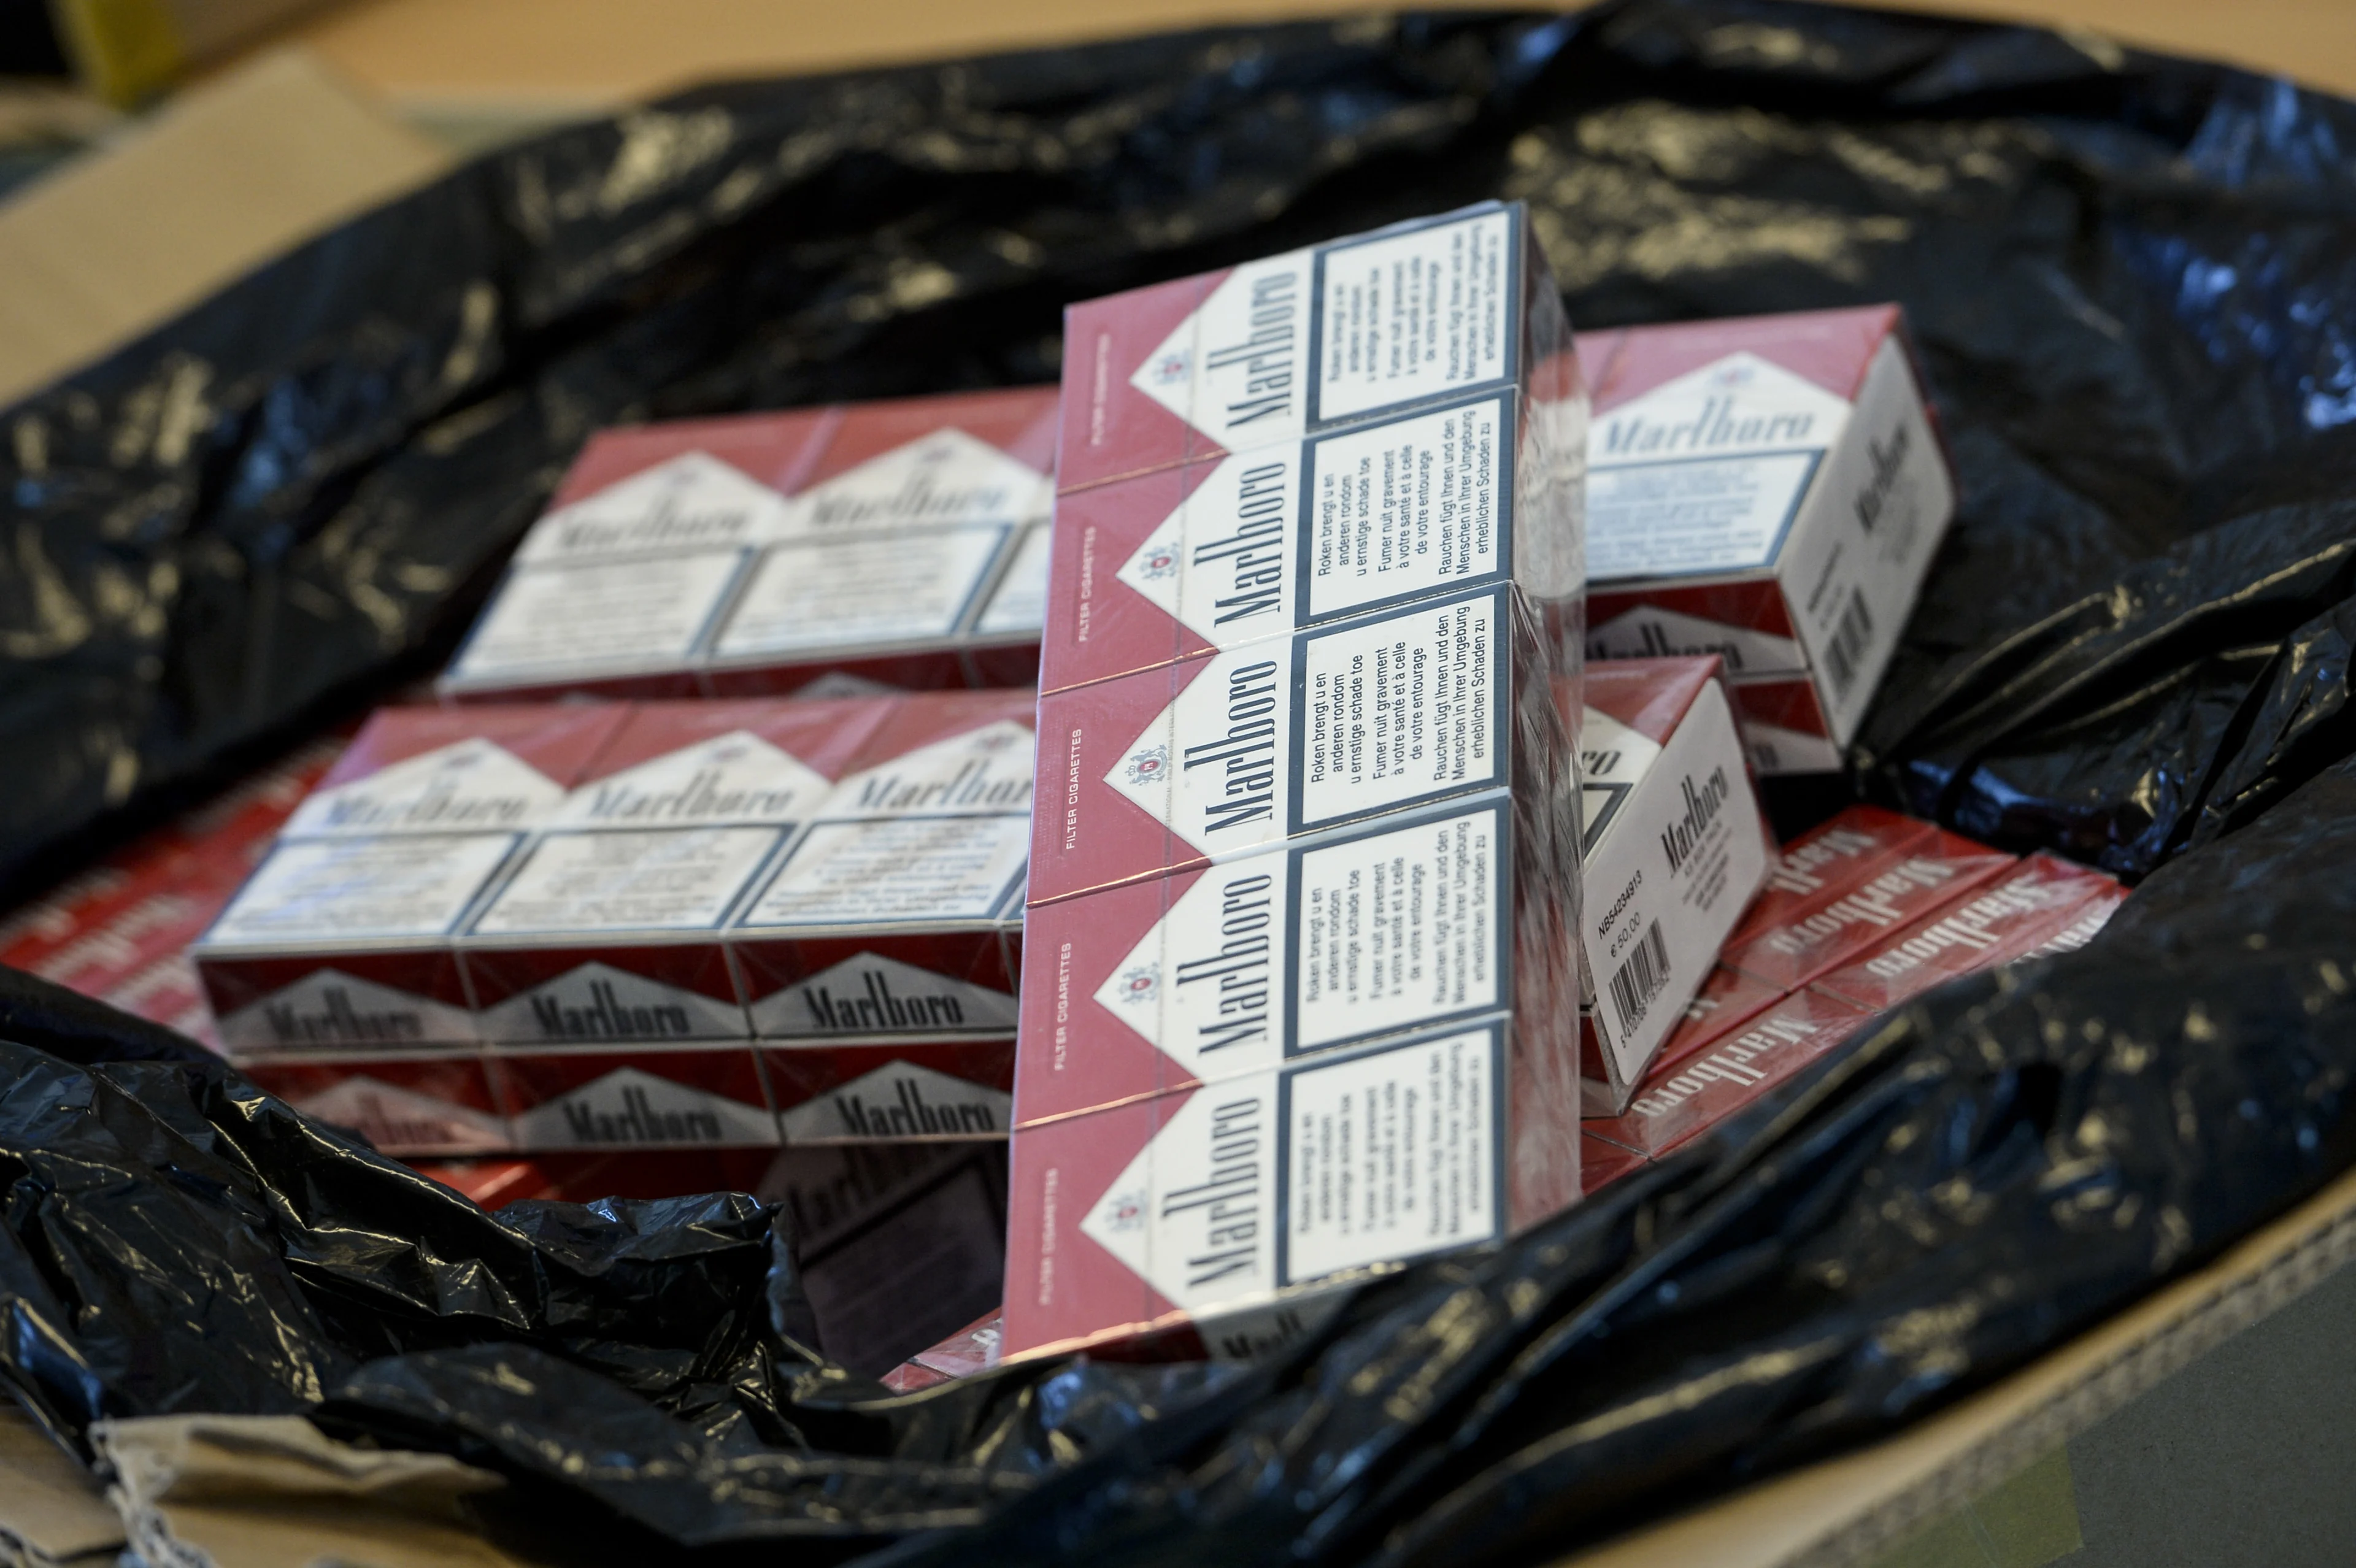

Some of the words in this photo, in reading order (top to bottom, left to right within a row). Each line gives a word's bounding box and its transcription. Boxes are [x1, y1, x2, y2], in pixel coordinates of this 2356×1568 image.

[1206, 270, 1298, 430] Marlboro
[1442, 418, 1455, 440] den
[1458, 410, 1477, 473] Umgebung
[1479, 421, 1491, 436] zu
[1358, 456, 1371, 476] toe
[1399, 444, 1413, 471] celle
[1441, 442, 1455, 464] und
[1476, 437, 1490, 487] Schaden
[1323, 473, 1334, 488] en
[1323, 489, 1334, 499] u
[1339, 474, 1352, 518] rondom
[1356, 477, 1370, 518] schade
[1382, 449, 1397, 509] gravement
[1399, 482, 1412, 494] et
[1416, 450, 1434, 507] entourage
[1440, 465, 1454, 498] Ihnen
[1457, 475, 1472, 502] Ihrer
[1319, 499, 1337, 538] brengt
[1379, 510, 1393, 533] nuit
[1397, 496, 1411, 528] santé
[1415, 509, 1429, 539] votre
[1439, 499, 1457, 523] fügt
[1457, 502, 1471, 515] in
[1474, 488, 1489, 554] erheblichen
[1193, 462, 1286, 628] Marlboro
[1317, 539, 1332, 577] Roken
[1336, 520, 1350, 566] anderen
[1354, 520, 1372, 566] ernstige
[1377, 536, 1392, 572] Fumer
[1397, 529, 1411, 559] votre
[1414, 540, 1428, 555] de
[1438, 524, 1453, 575] Rauchen
[1455, 515, 1471, 575] Menschen
[1081, 527, 1096, 599] CIGARETTES
[1356, 567, 1367, 577] u
[1395, 560, 1409, 569] à
[1079, 602, 1090, 641] FILTER
[1434, 614, 1449, 637] den
[1452, 605, 1471, 672] Umgebung
[1474, 618, 1485, 634] zu
[1349, 654, 1363, 675] toe
[1392, 641, 1406, 670] celle
[1434, 639, 1449, 663] und
[1470, 634, 1485, 687] Schaden
[1315, 672, 1326, 688] en
[1315, 690, 1326, 699] u
[1374, 647, 1391, 712] gravement
[1391, 671, 1406, 680] à
[1392, 682, 1406, 696] et
[1410, 647, 1427, 709] entourage
[1434, 664, 1449, 699] Ihnen
[1452, 674, 1466, 702] Ihrer
[1330, 674, 1345, 721] rondom
[1348, 677, 1363, 721] schade
[1391, 698, 1406, 732] santé
[1433, 699, 1452, 726] fügt
[1452, 703, 1466, 717] in
[1311, 700, 1330, 742] brengt
[1372, 713, 1387, 738] nuit
[1409, 710, 1423, 743] votre
[1470, 688, 1485, 759] erheblichen
[1068, 729, 1081, 804] CIGARETTES
[1183, 660, 1277, 836] Marlboro
[1311, 743, 1325, 783] Roken
[1329, 723, 1344, 772] anderen
[1347, 723, 1366, 773] ernstige
[1372, 740, 1387, 780] Fumer
[1392, 734, 1405, 766] votre
[1408, 744, 1423, 760] de
[1433, 726, 1448, 781] Rauchen
[1451, 717, 1466, 781] Menschen
[855, 759, 1034, 810] Marlbor
[1350, 775, 1361, 784] u
[1390, 767, 1404, 775] à
[1066, 809, 1077, 850] FILTER
[1660, 766, 1729, 879] Marlboro
[1598, 869, 1642, 940] NB54234913
[1769, 854, 1955, 955] Marlboro
[1618, 912, 1641, 949] 50,00
[1865, 872, 2051, 977] Marlboro
[1057, 943, 1071, 1023] CIGARETTES
[1176, 874, 1272, 1057] Marlboro
[531, 980, 692, 1037] Marlboro
[803, 970, 965, 1029] Marlboro
[1055, 1027, 1067, 1070] FILTER
[1631, 1012, 1820, 1118] Marlboro
[836, 1080, 998, 1136] Marlboro
[1163, 1097, 1260, 1288] Marlboro
